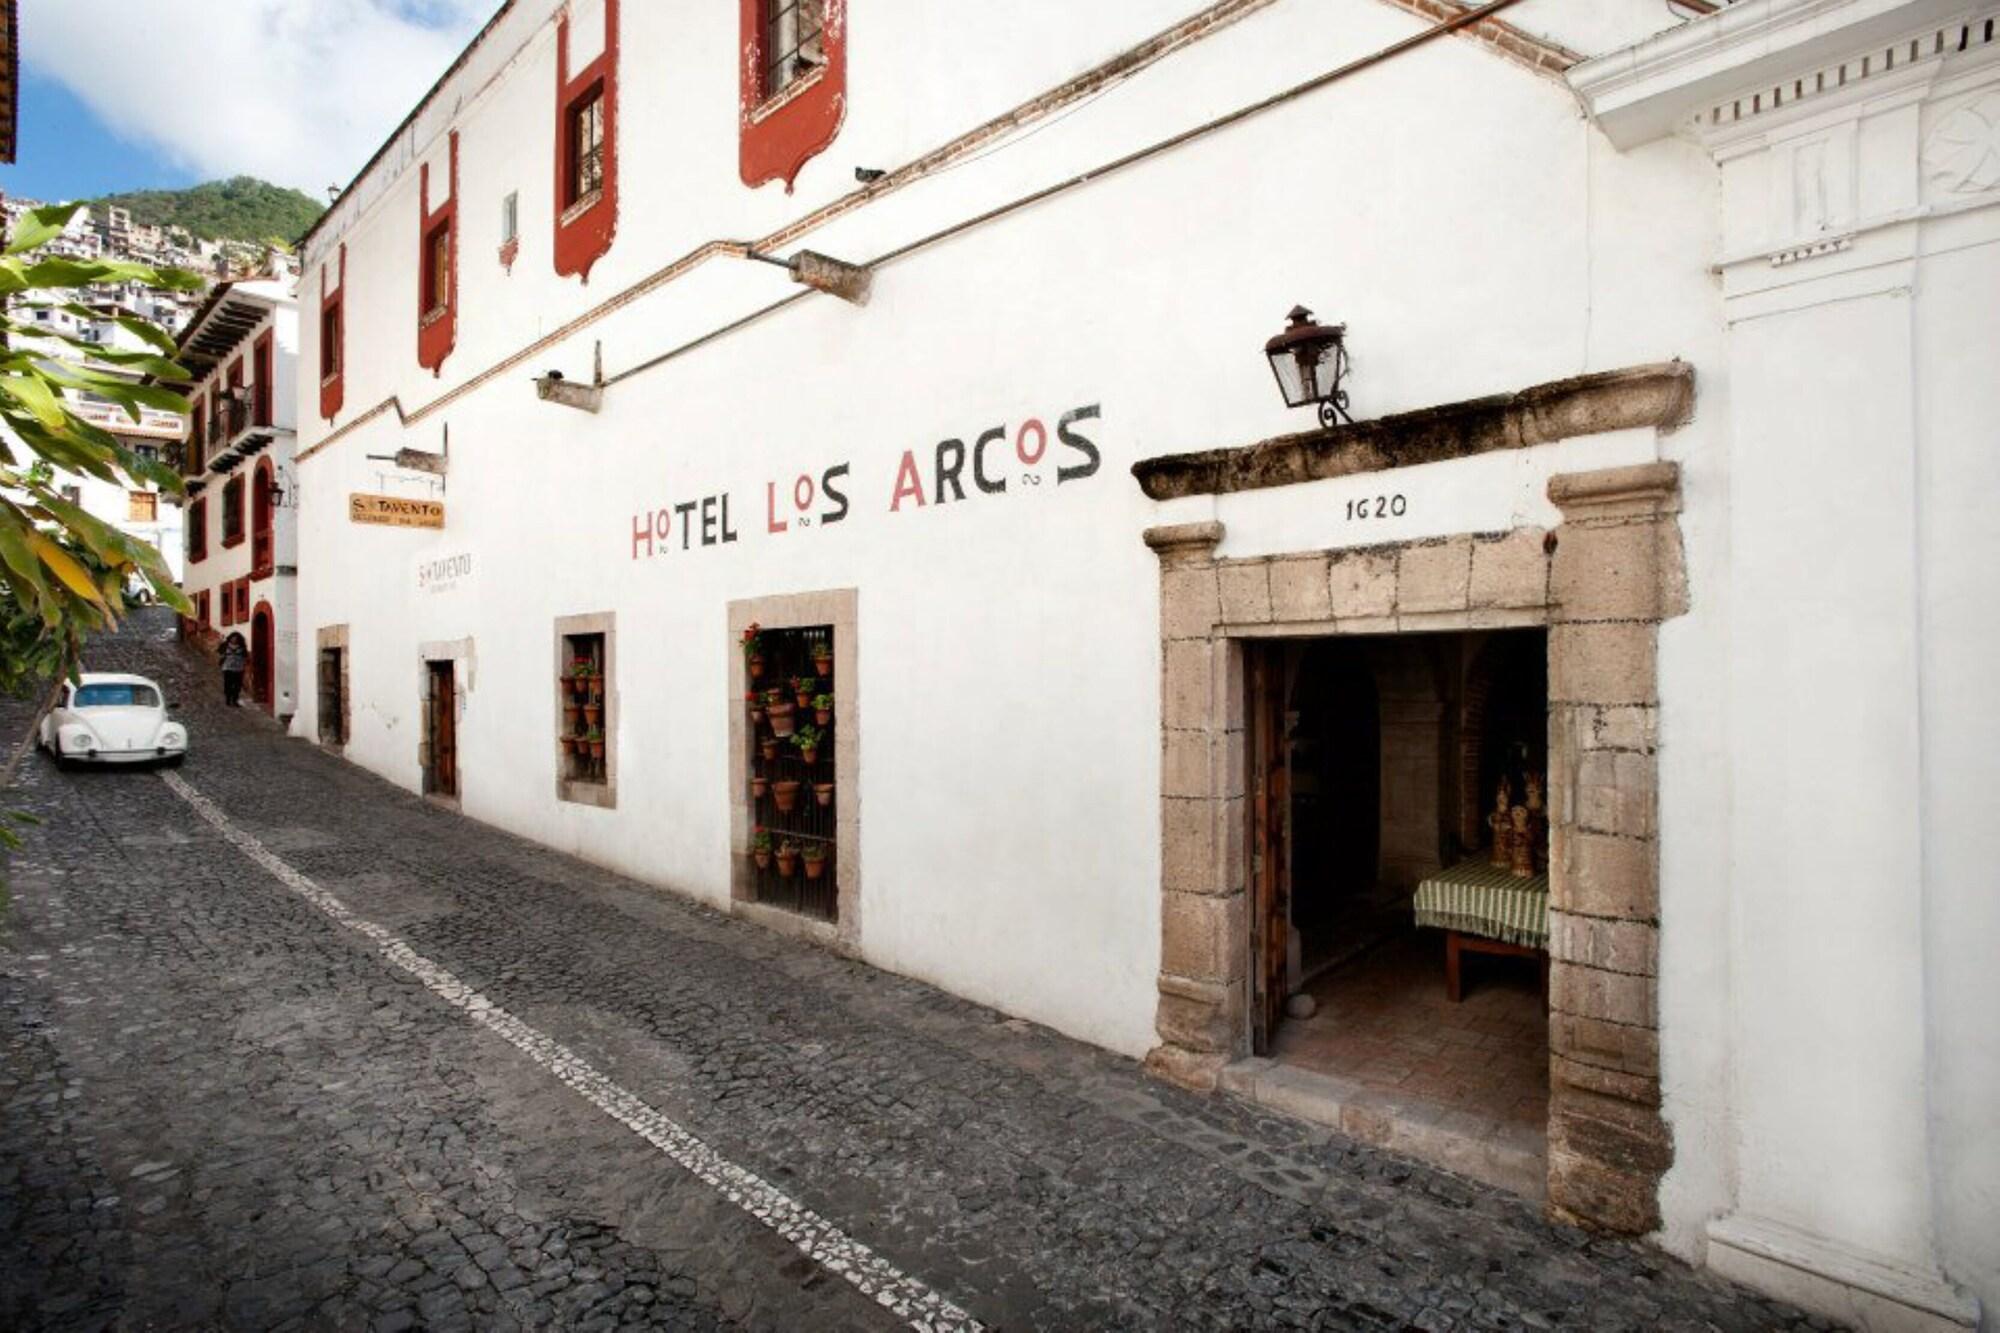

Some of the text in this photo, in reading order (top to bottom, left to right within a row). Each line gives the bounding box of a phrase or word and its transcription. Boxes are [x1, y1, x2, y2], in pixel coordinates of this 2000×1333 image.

[632, 402, 1101, 560] HOTEL LOS ARCOS
[1346, 493, 1407, 521] 1620
